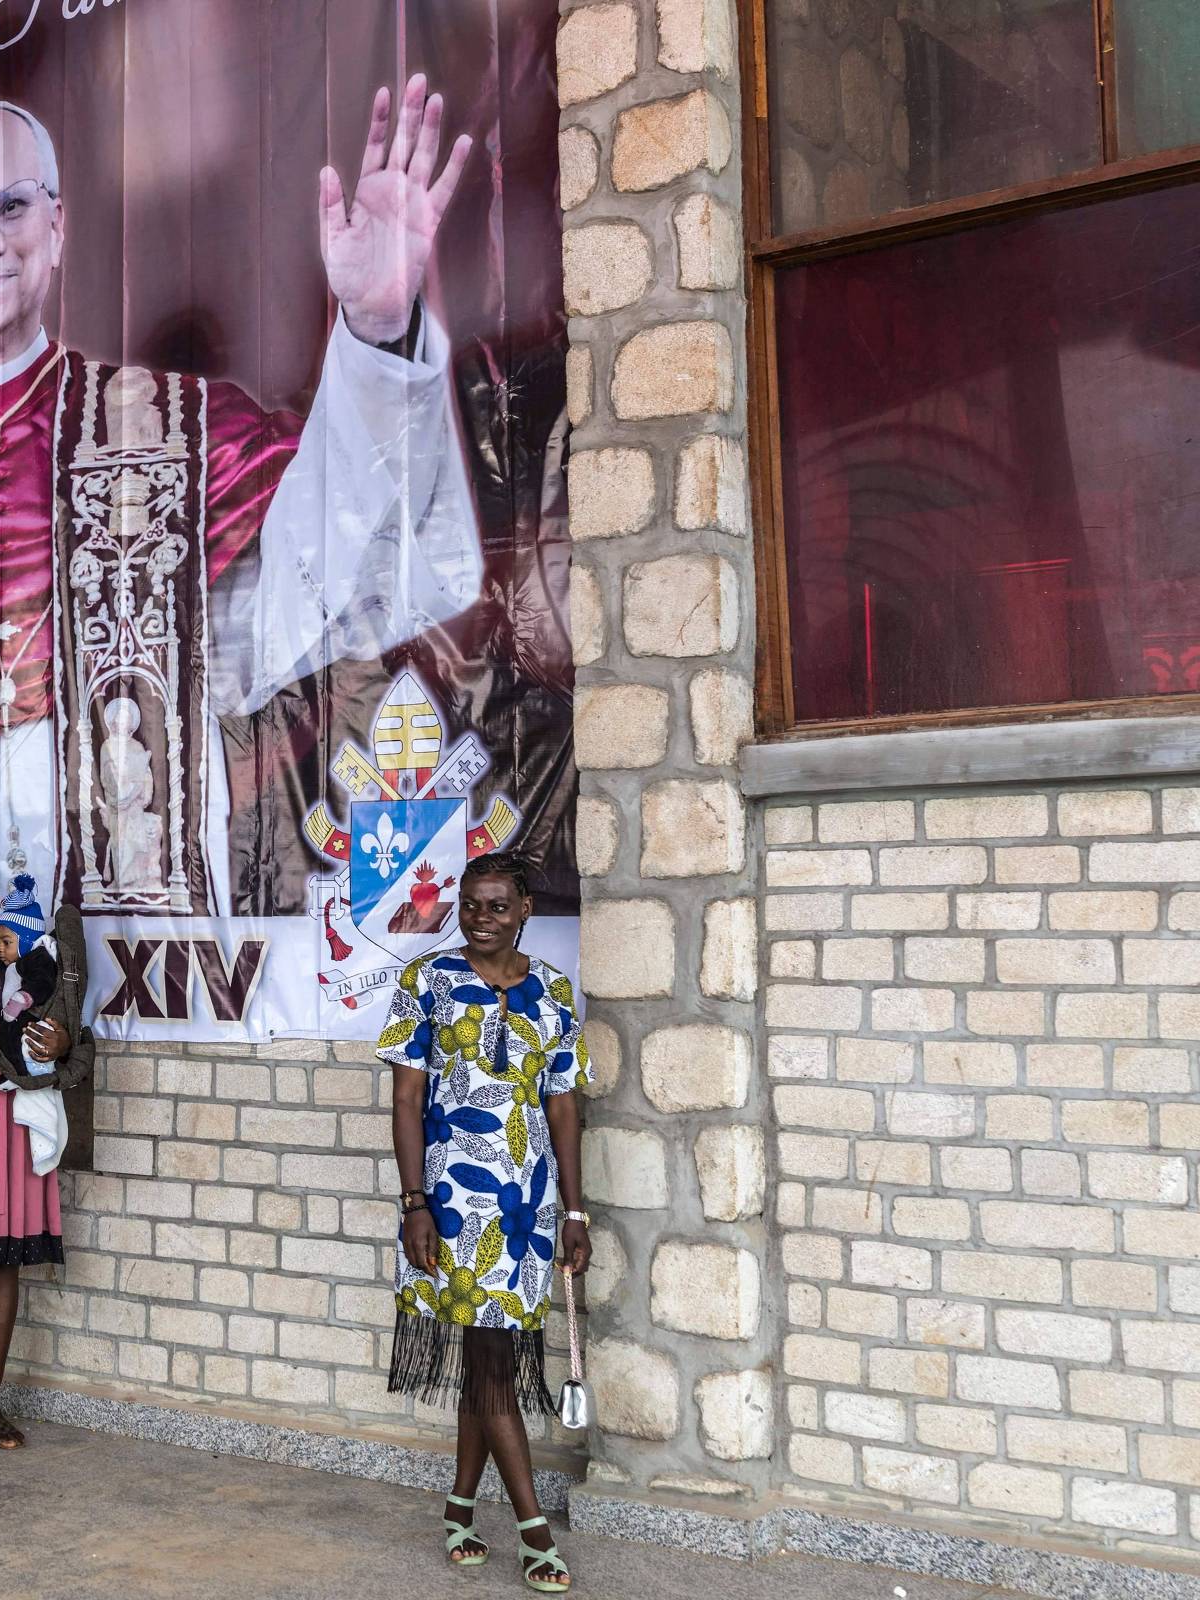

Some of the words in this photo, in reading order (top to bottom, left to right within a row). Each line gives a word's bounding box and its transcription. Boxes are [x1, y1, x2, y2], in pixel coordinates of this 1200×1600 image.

[99, 938, 267, 1022] XIV
[337, 979, 353, 997] IN
[359, 971, 388, 989] ILLO
